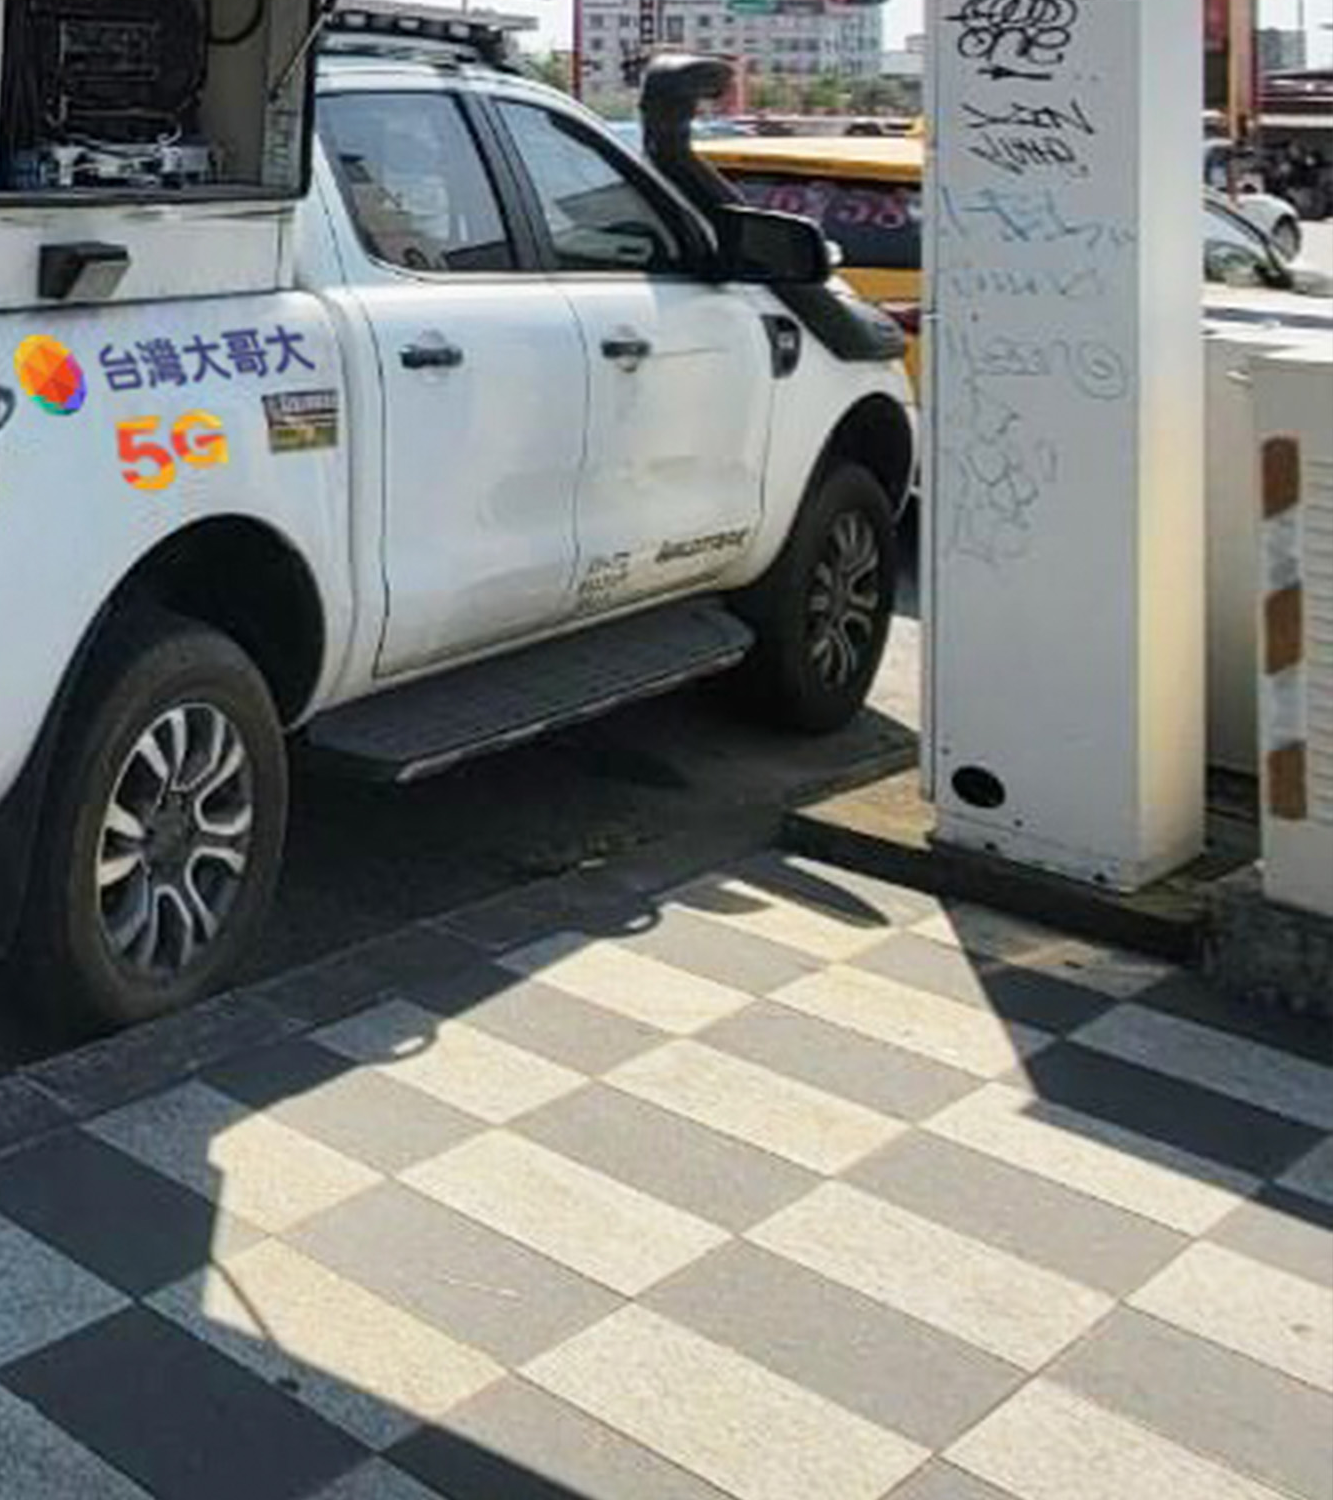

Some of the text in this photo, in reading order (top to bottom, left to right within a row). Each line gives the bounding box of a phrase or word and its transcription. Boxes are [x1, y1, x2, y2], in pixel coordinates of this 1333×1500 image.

[99, 325, 315, 391] 台灣大哥大
[116, 409, 230, 491] 5G
